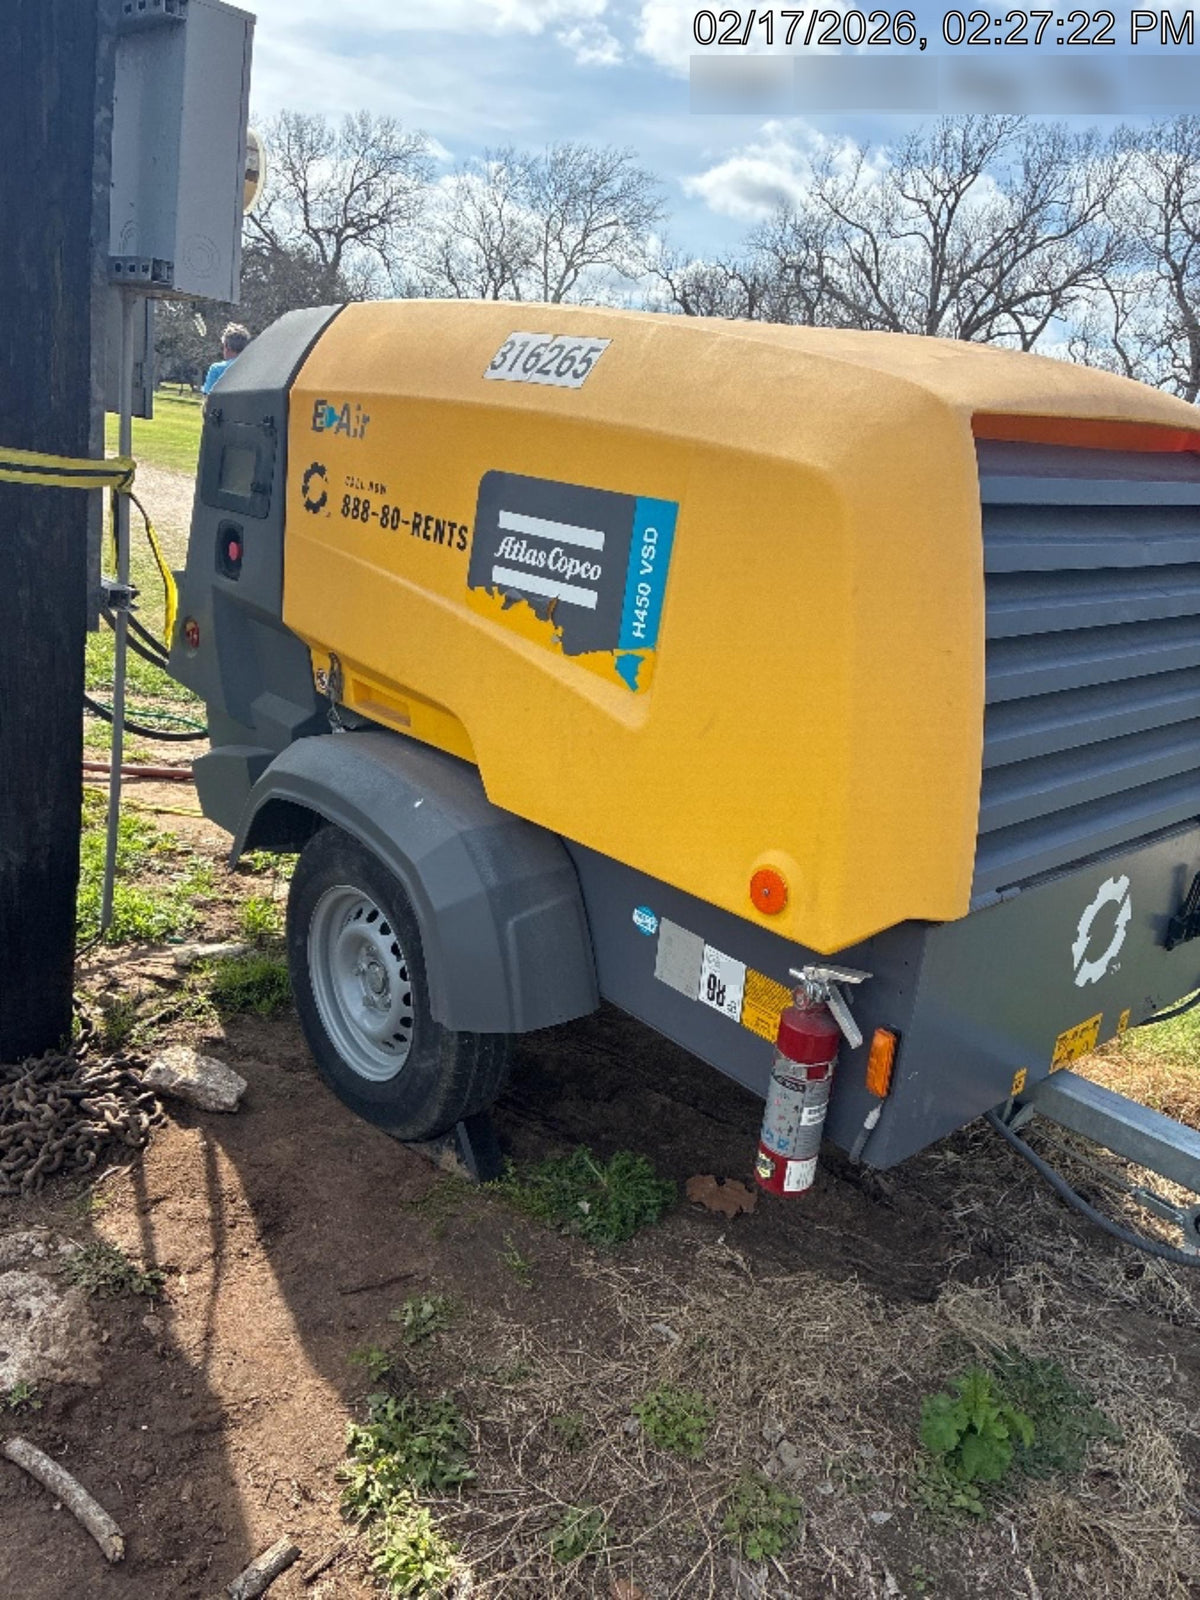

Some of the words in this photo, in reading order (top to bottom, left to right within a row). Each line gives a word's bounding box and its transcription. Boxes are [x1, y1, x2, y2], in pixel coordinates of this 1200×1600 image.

[490, 340, 602, 379] 316265
[341, 494, 468, 551] 888-80-RENTS
[640, 527, 659, 575] VSD
[632, 582, 652, 639] H450
